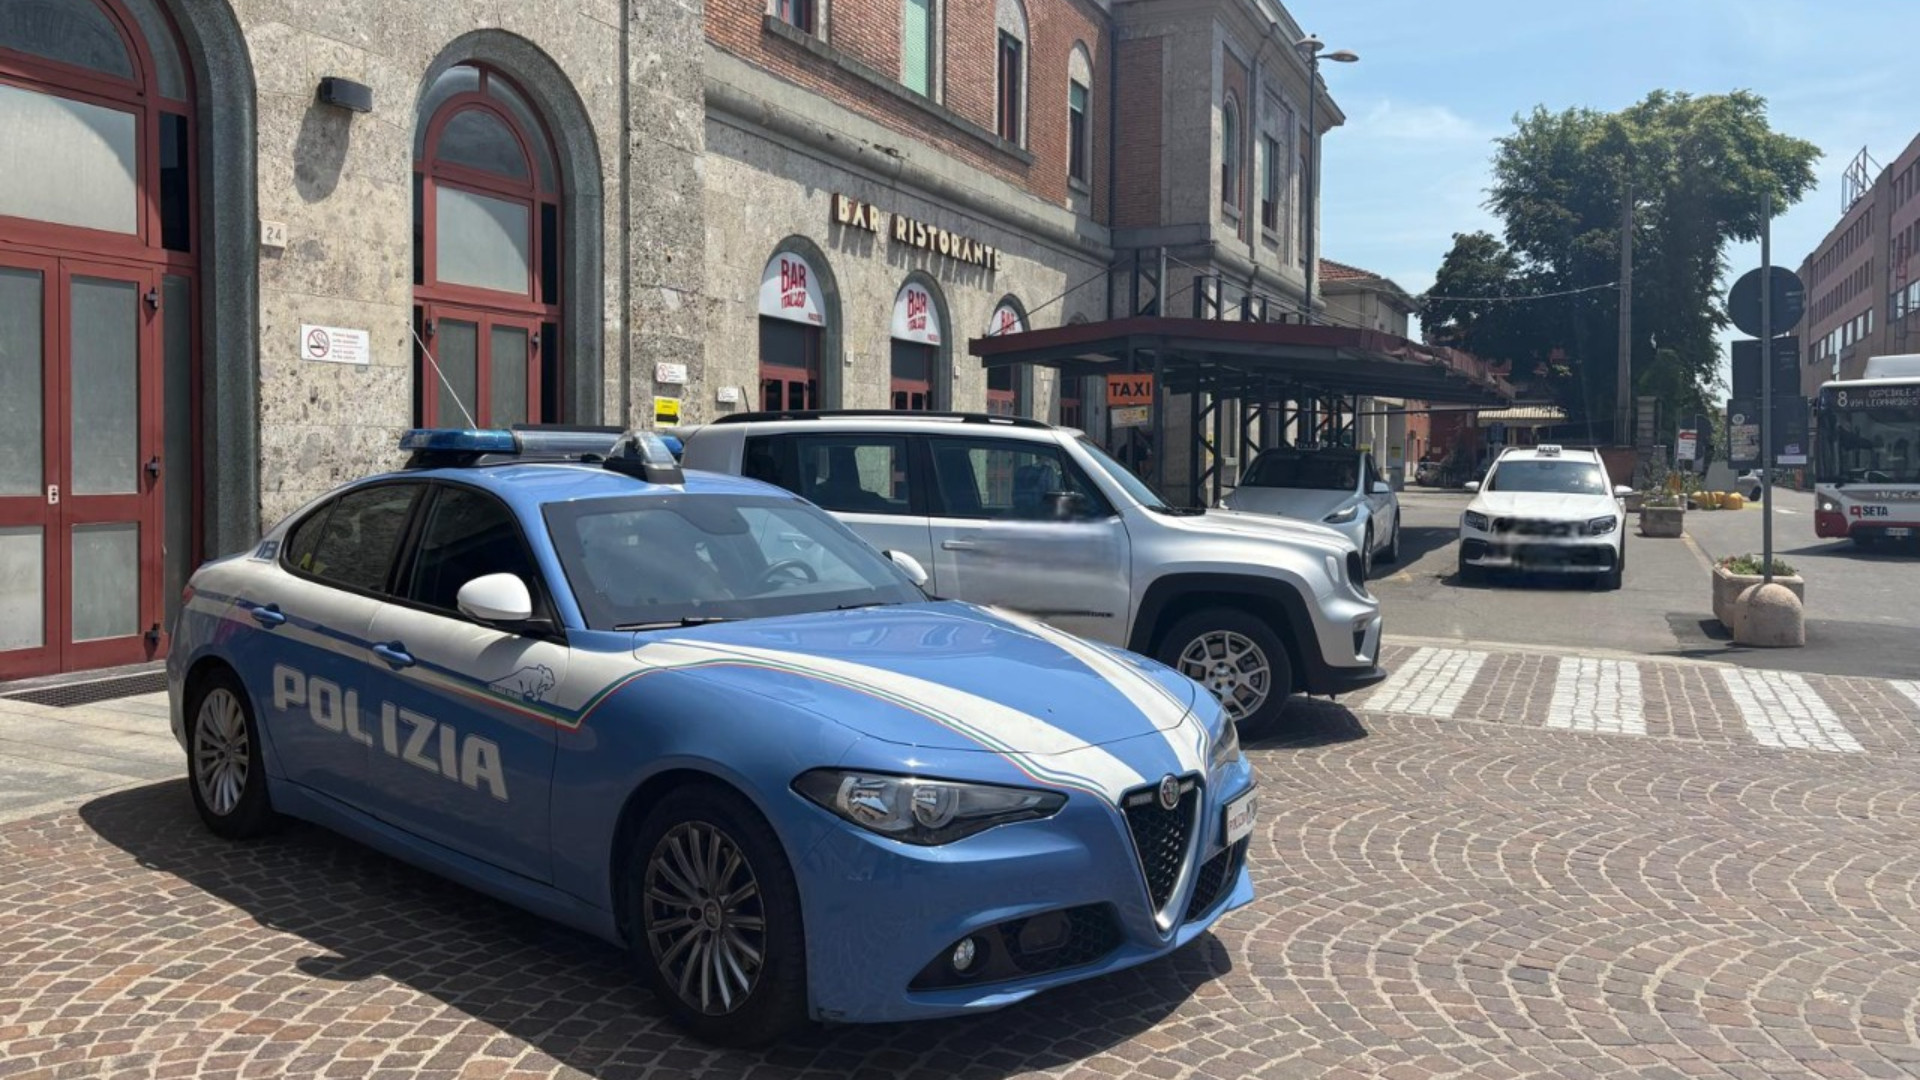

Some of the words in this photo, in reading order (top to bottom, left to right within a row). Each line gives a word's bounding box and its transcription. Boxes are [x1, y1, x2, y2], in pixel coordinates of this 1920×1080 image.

[266, 226, 281, 241] 24
[834, 193, 880, 232] BAR
[893, 214, 1001, 271] RISTORANTE
[781, 258, 806, 293] BAR
[908, 289, 927, 318] BAR
[1109, 381, 1151, 397] TAXI
[1838, 391, 1848, 407] 8
[1862, 505, 1888, 516] SETA
[273, 662, 508, 802] POLIZIA
